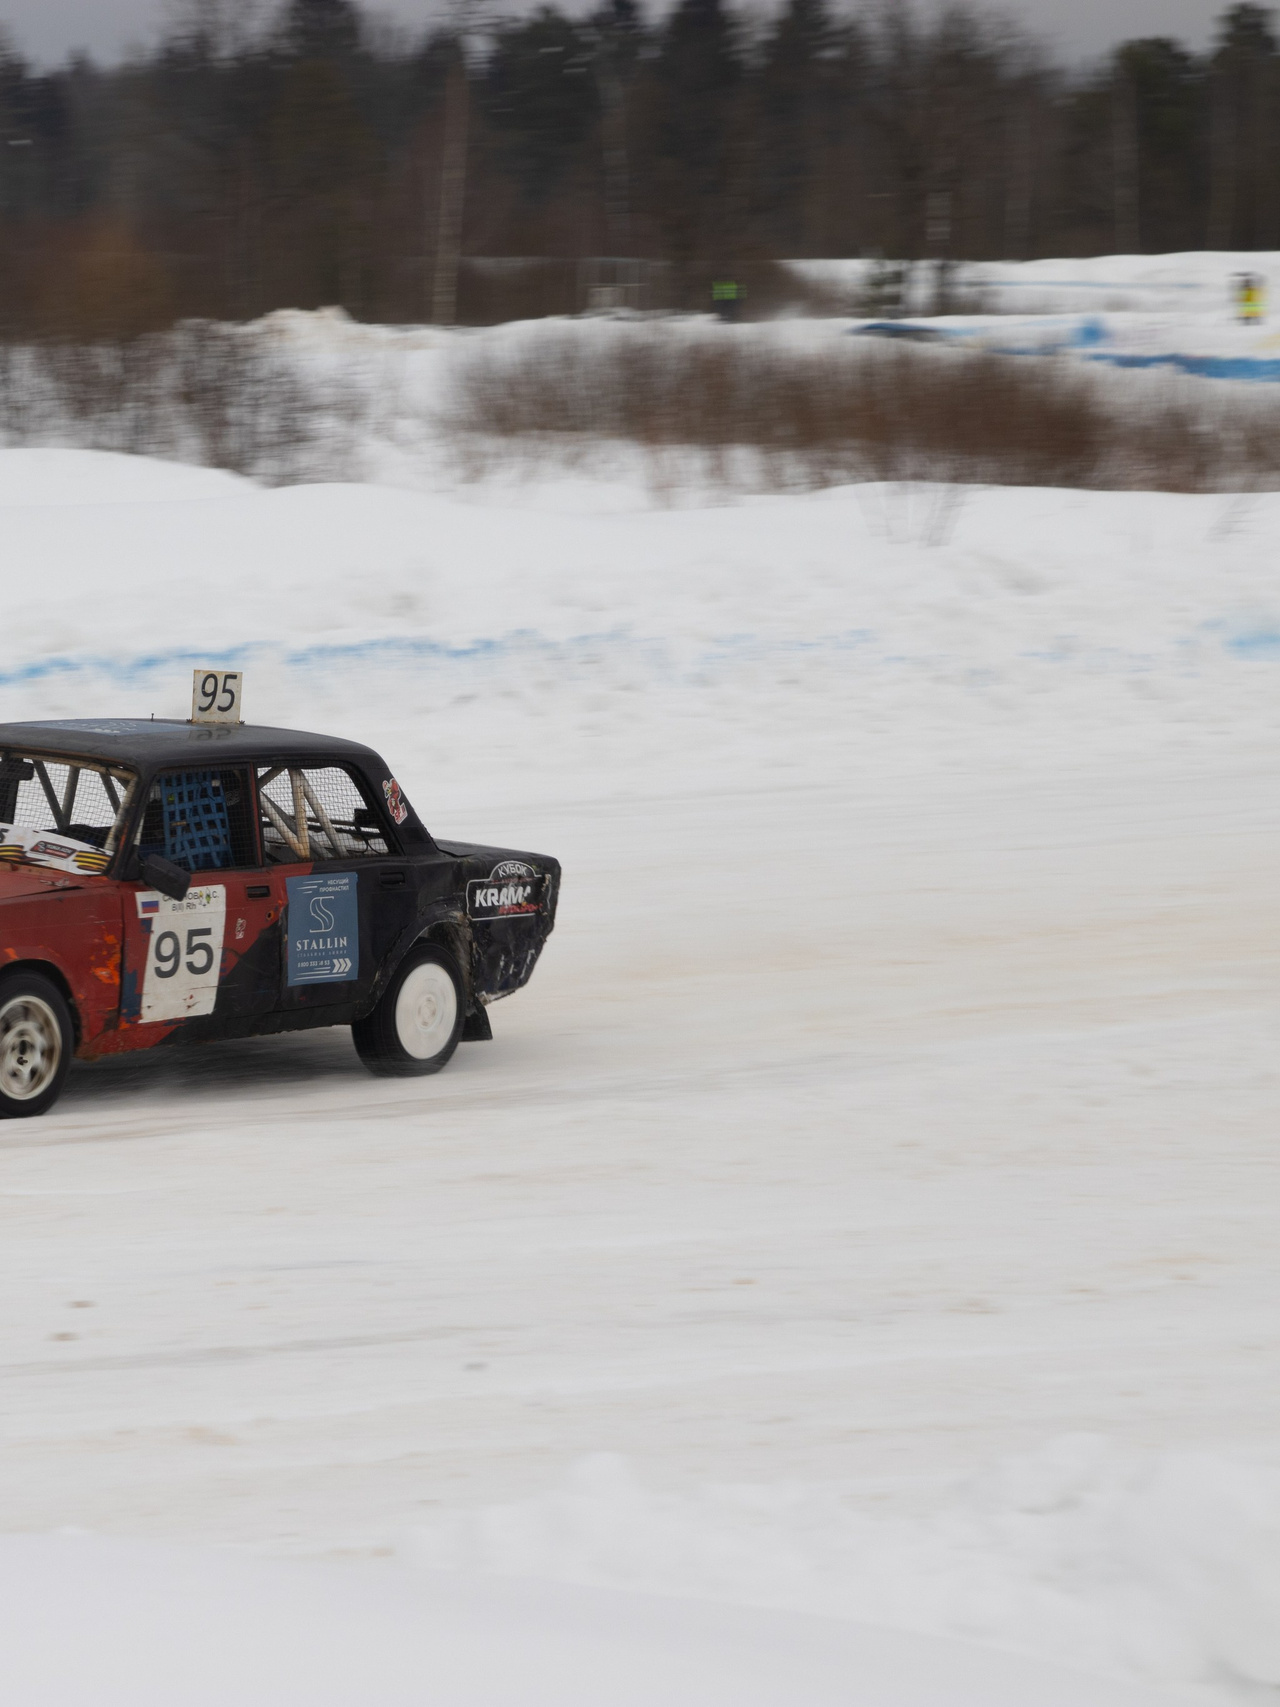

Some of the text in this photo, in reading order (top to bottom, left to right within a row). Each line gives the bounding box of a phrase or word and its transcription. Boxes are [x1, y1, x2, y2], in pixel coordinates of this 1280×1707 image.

[198, 673, 238, 712] 95
[498, 863, 528, 878] КУБОК
[475, 885, 531, 907] KRAM
[154, 928, 214, 979] 95
[296, 937, 347, 951] STALLIN
